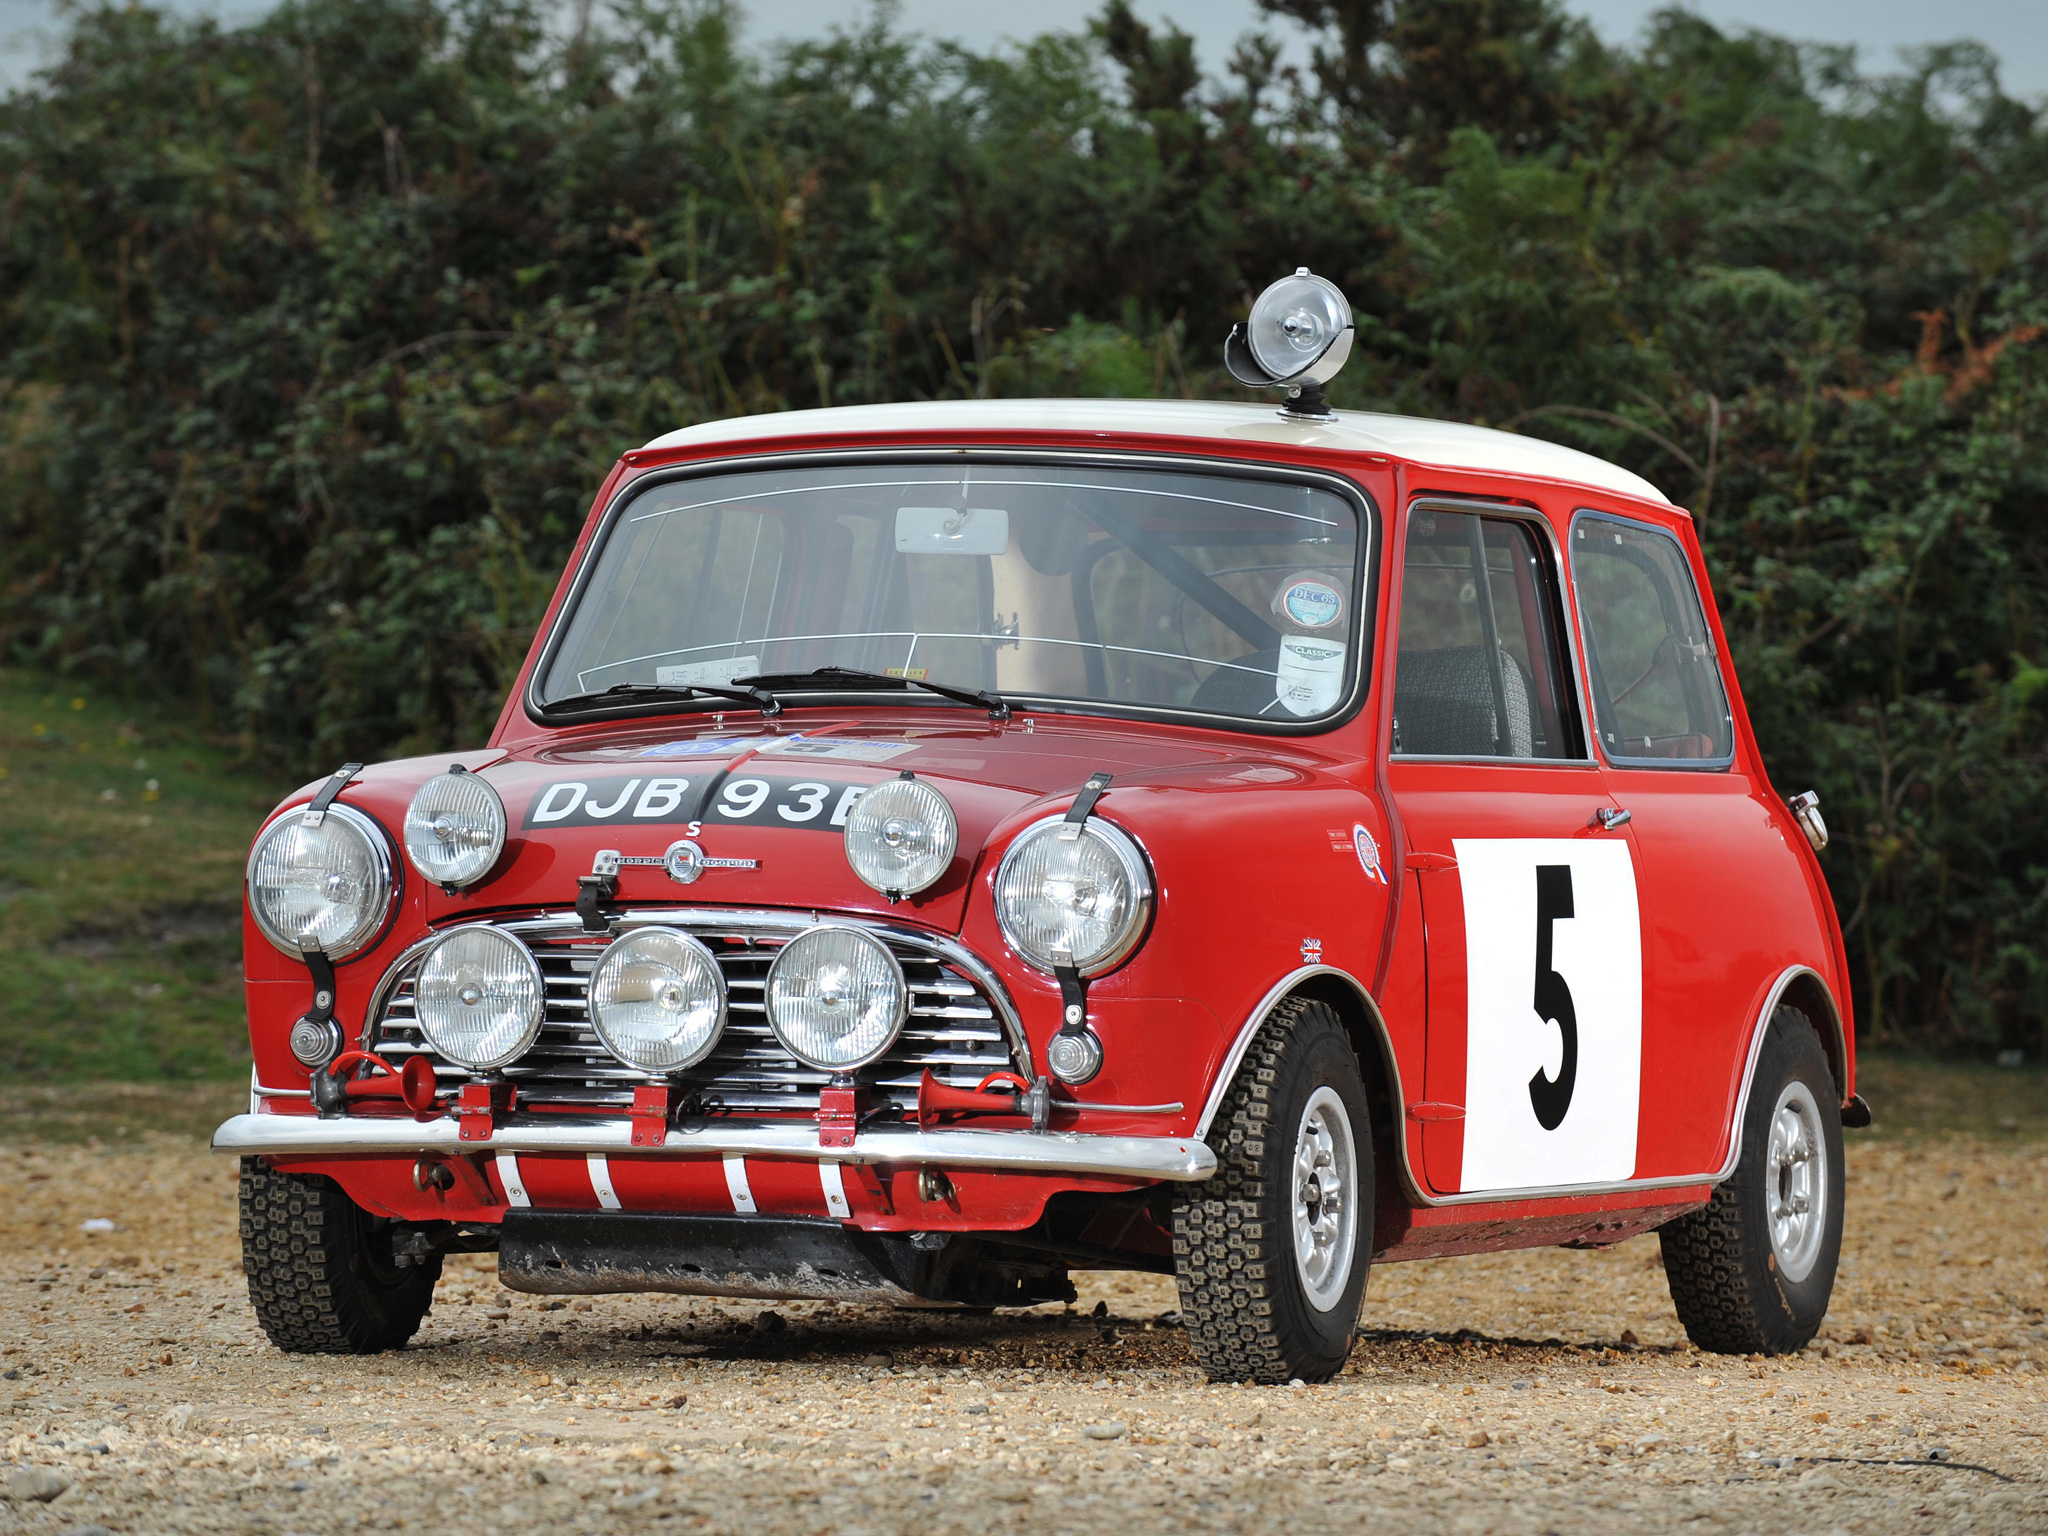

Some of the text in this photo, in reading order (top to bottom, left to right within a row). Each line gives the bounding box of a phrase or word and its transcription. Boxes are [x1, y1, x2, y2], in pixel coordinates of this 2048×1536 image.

[1294, 588, 1336, 604] DEC 65
[1295, 646, 1331, 658] CLASSIC
[784, 743, 836, 753] 5
[532, 778, 689, 823] DJB
[685, 820, 702, 837] S
[1528, 865, 1578, 1131] 5
